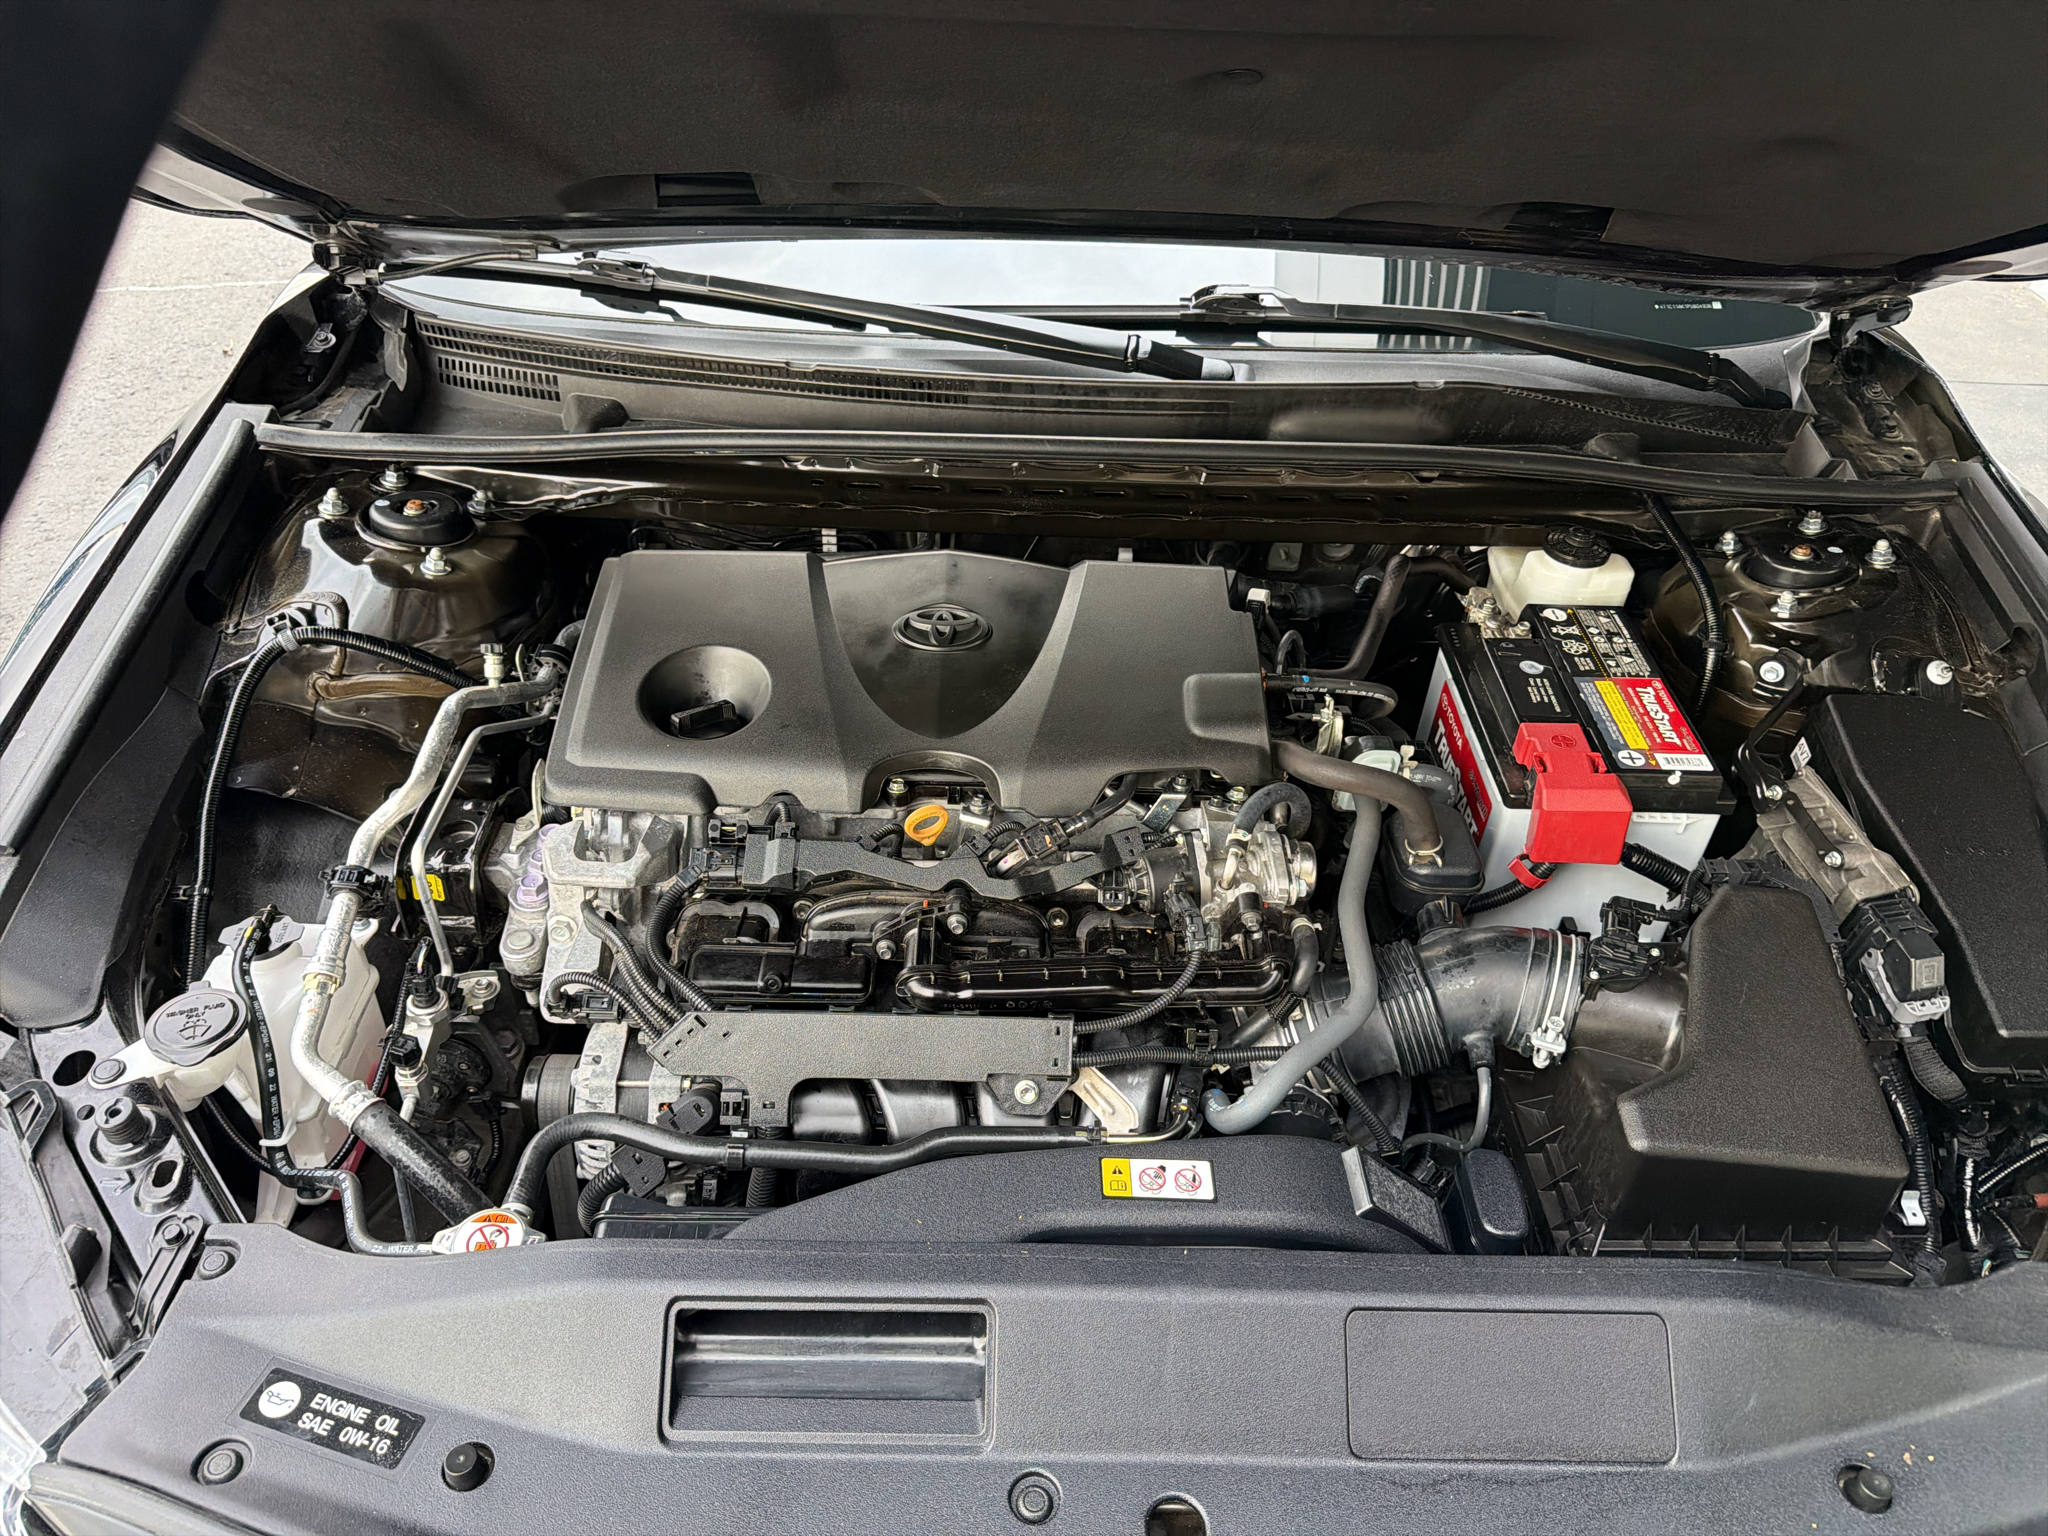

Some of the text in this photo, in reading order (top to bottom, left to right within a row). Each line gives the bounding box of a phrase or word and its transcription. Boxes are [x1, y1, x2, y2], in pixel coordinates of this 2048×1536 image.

[1657, 689, 1676, 712] TOYOTA
[1446, 708, 1462, 750] TOYOTA
[204, 1002, 226, 1012] FLUID
[252, 1001, 264, 1020] WATER
[265, 1052, 273, 1064] 21
[269, 1082, 277, 1092] 22
[270, 1094, 279, 1116] WATER
[370, 1244, 382, 1252] 22
[388, 1244, 414, 1253] WATER
[310, 1392, 401, 1436] ENGINE OIL
[298, 1412, 390, 1455] SAE 0W-16
